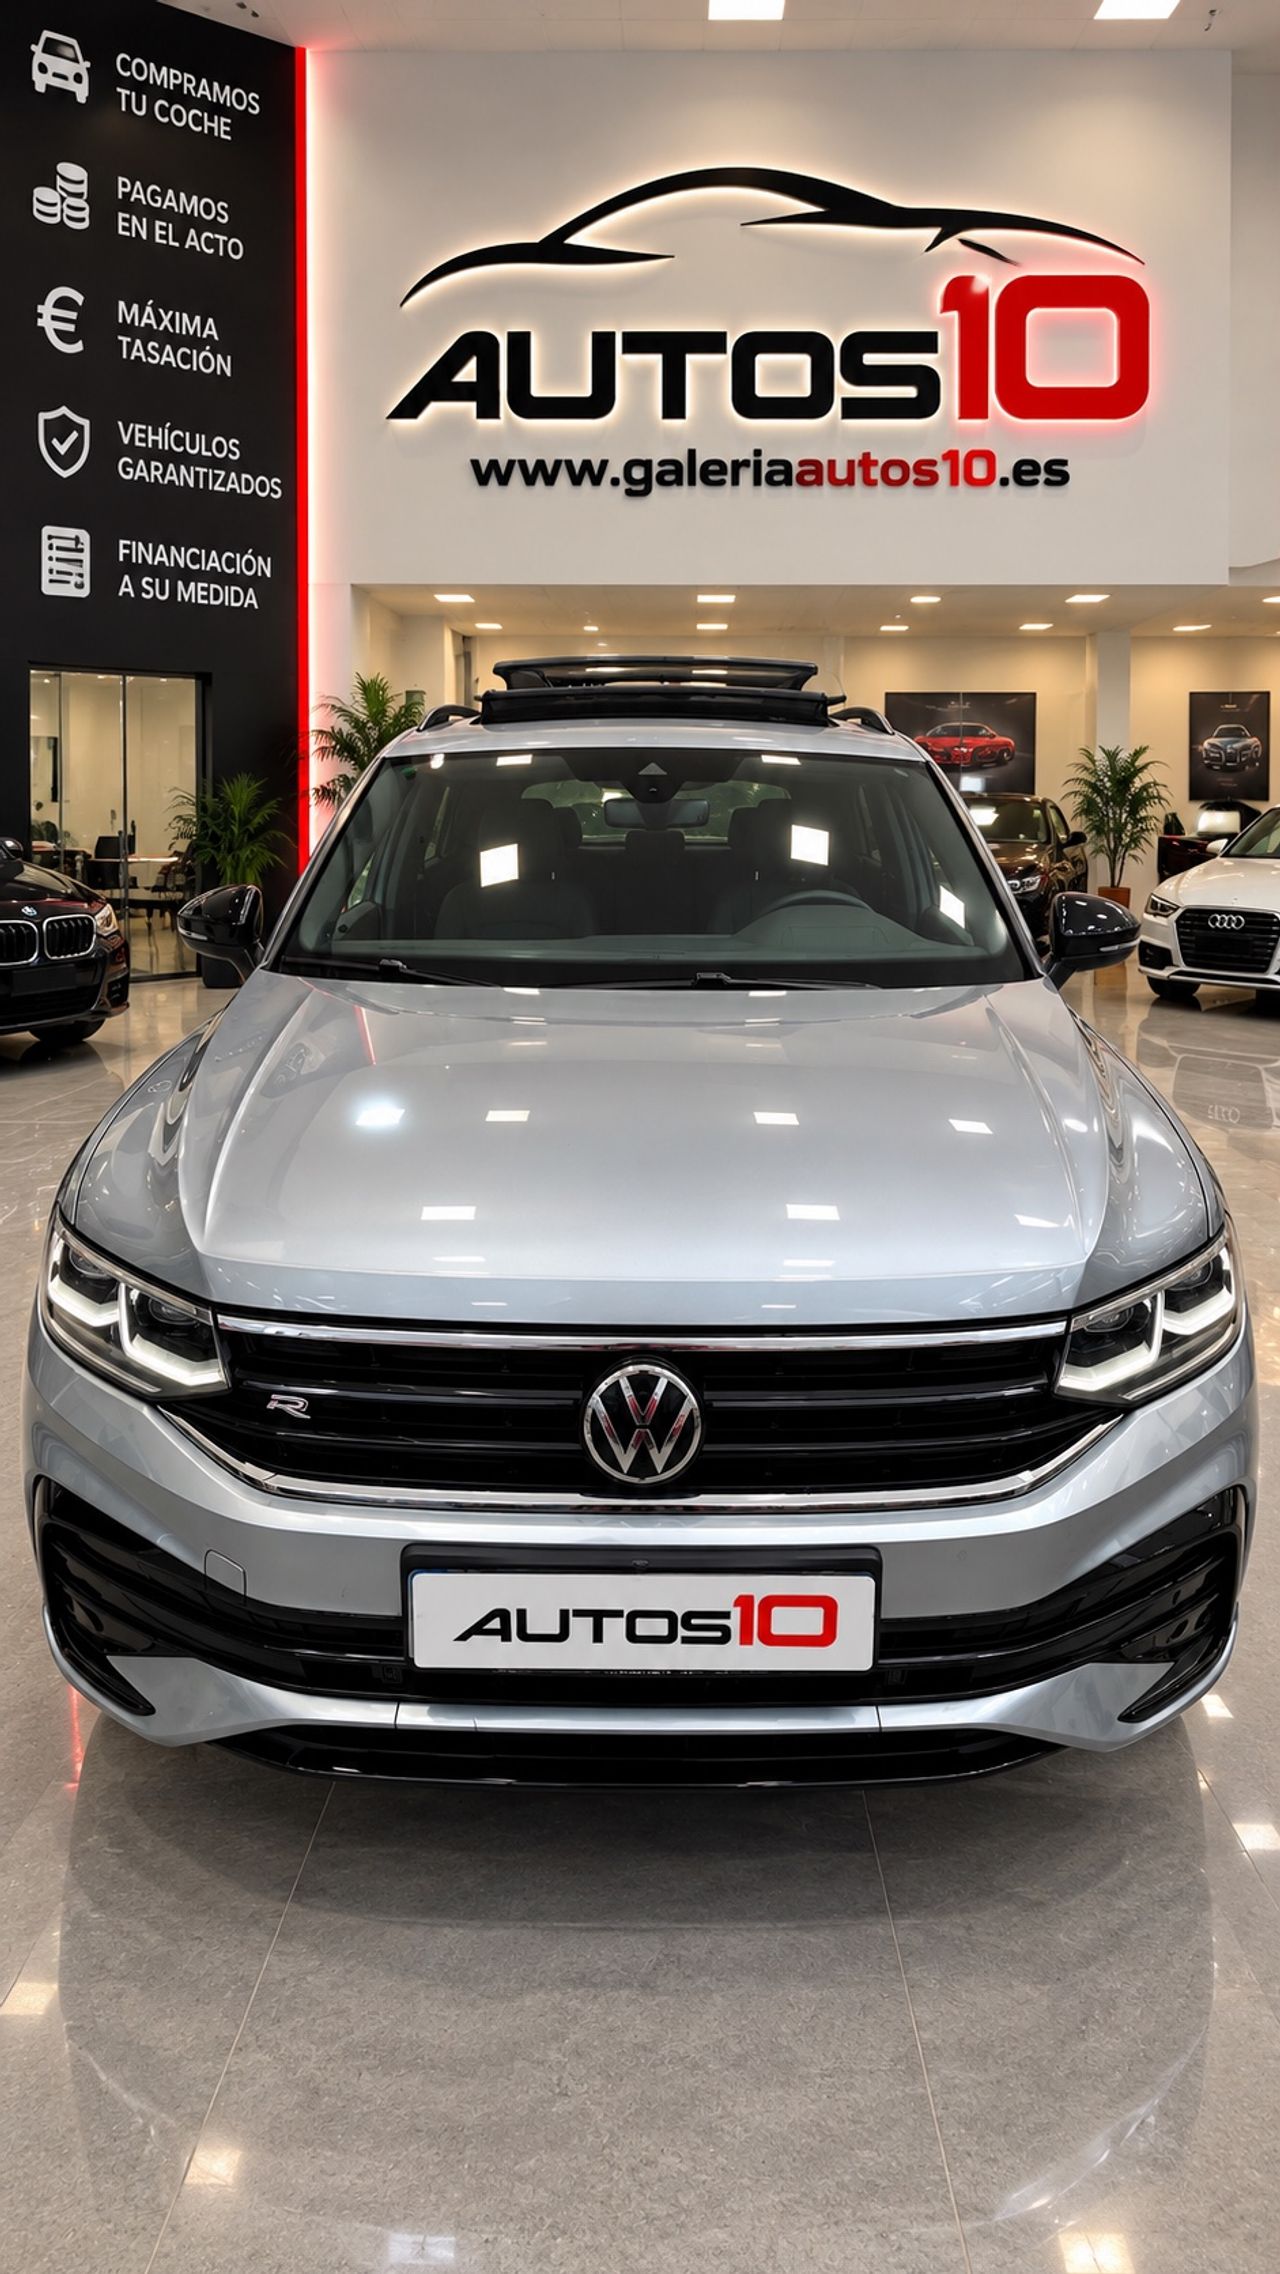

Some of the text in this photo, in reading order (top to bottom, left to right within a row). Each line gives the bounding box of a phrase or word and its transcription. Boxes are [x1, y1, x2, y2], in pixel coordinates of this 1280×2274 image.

[115, 52, 260, 115] COMPRAMOS
[116, 86, 232, 141] TU COCHE
[117, 175, 229, 224] PAGAMOS
[117, 211, 244, 260] EN EL ACTO
[117, 299, 220, 341] MÁXIMA
[117, 335, 232, 377] TASACIÓN
[386, 275, 1150, 420] AUTOS10
[117, 420, 241, 461] VEHÍCULOS
[117, 456, 283, 500] GARANTIZADOS
[469, 448, 1071, 498] www.galeriaautos10.es
[118, 538, 272, 578] FINANCIACIÓN
[118, 574, 259, 610] A SU MEDIDA
[453, 1594, 838, 1647] AUTOS10
